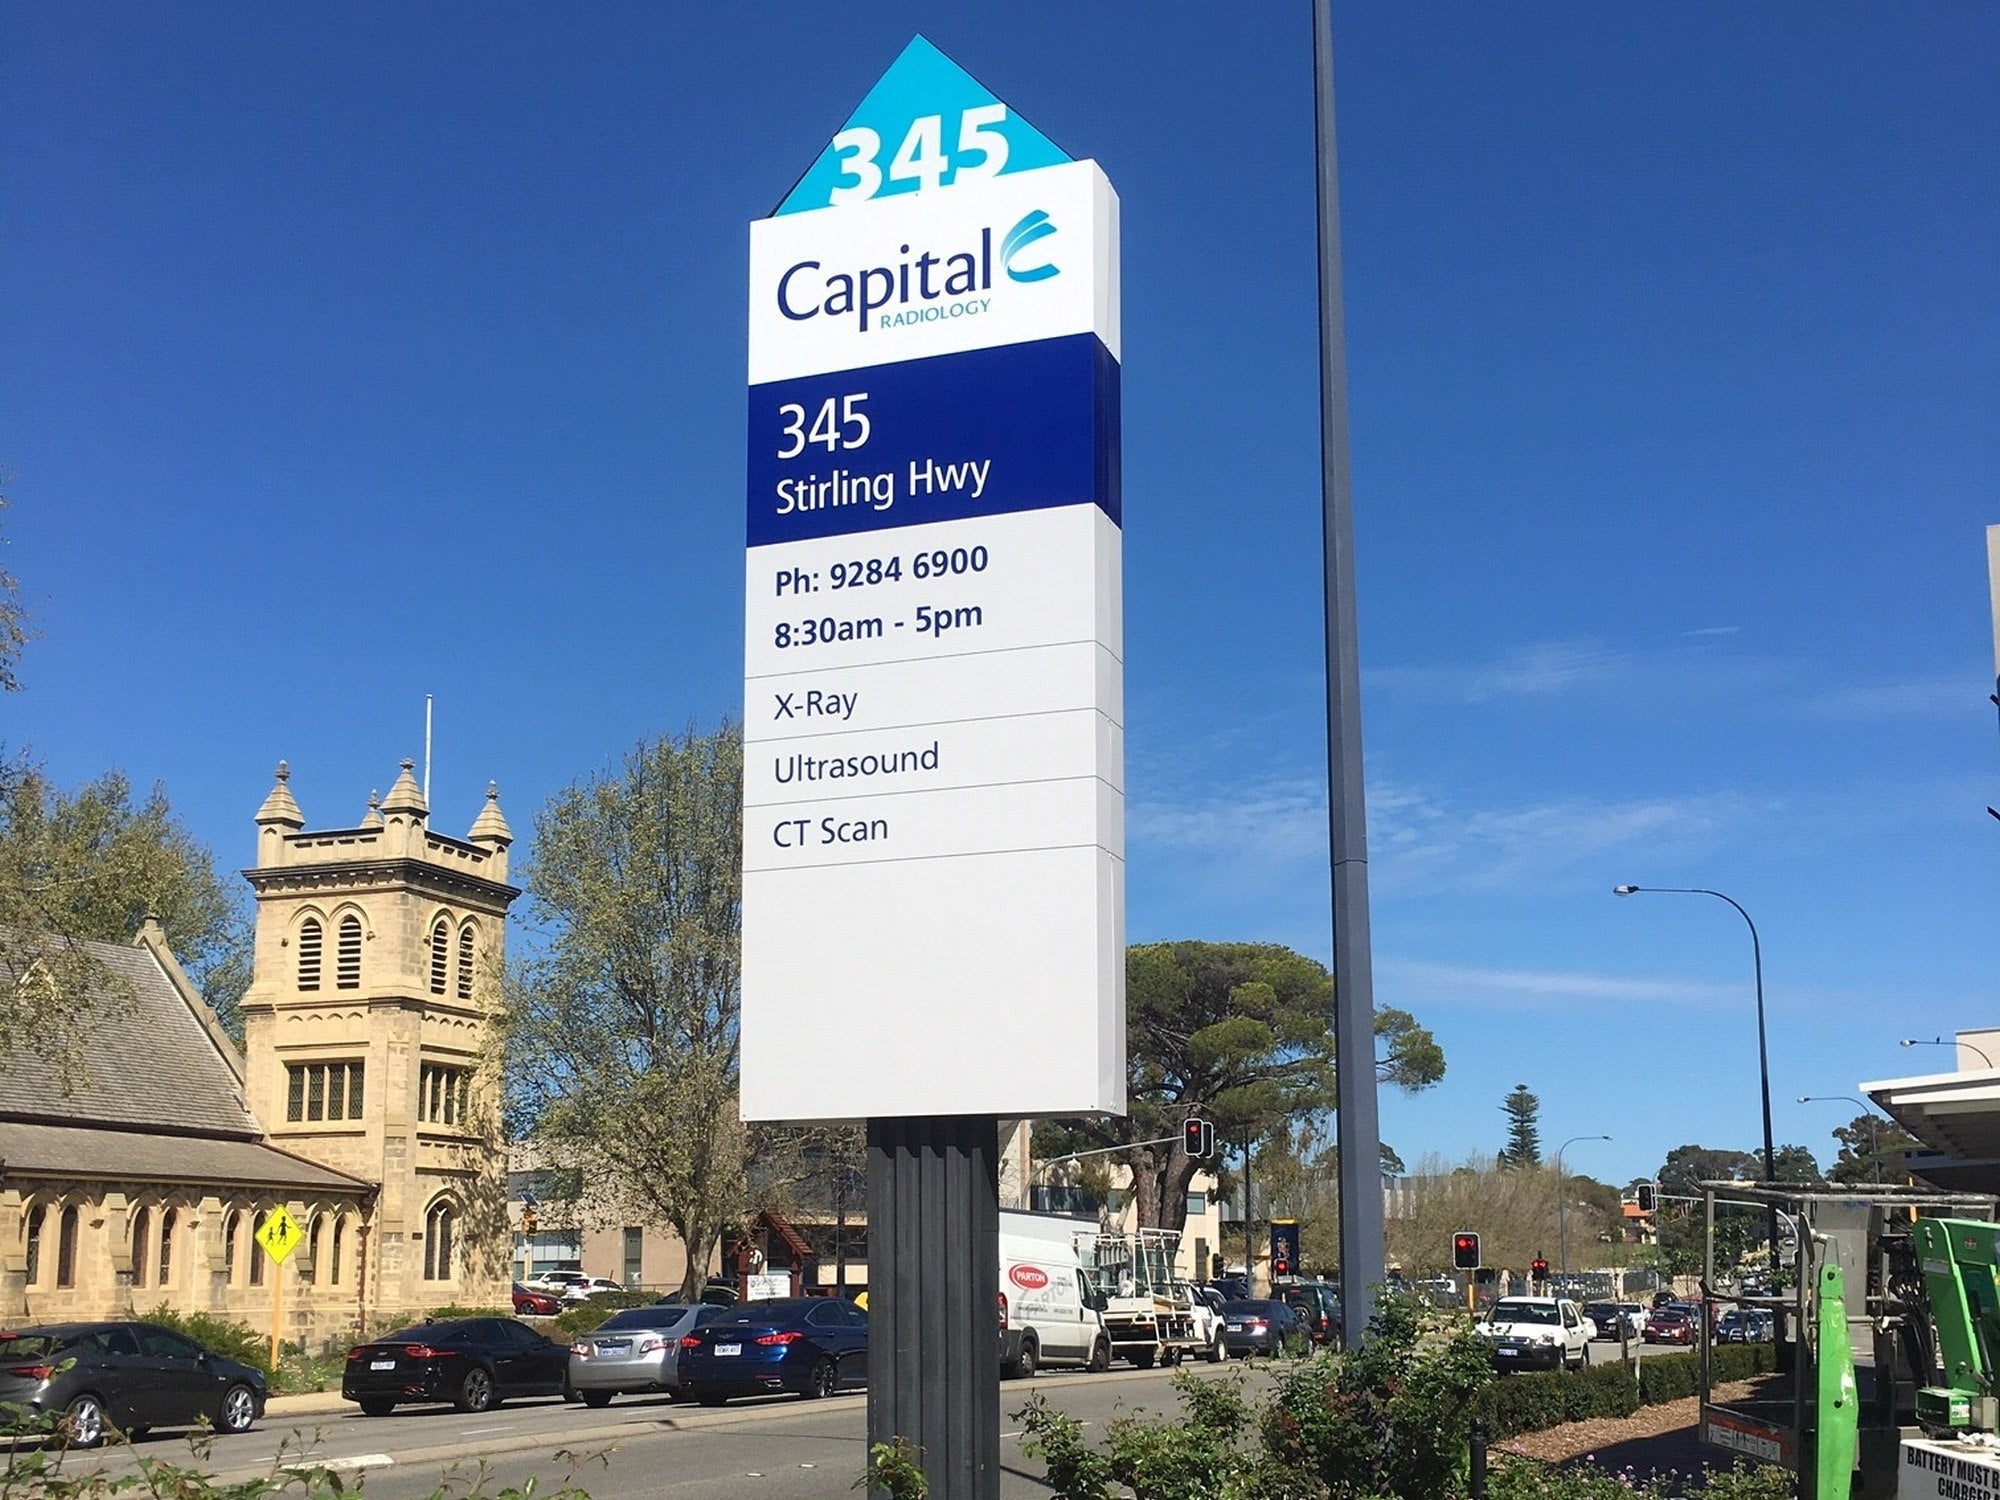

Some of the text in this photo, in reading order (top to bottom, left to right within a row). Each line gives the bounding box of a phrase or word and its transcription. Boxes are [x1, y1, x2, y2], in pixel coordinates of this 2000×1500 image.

[829, 103, 1010, 207] 345
[777, 227, 992, 332] Capital
[880, 298, 991, 329] RADIOLOGY
[777, 392, 871, 459] 345
[776, 458, 992, 514] Stirling Hwy
[776, 546, 989, 597] Ph: 9284 6900
[774, 617, 883, 649] 8:30am
[915, 606, 983, 639] 5pm
[774, 691, 858, 721] X-Ray
[775, 741, 939, 784] Ultrasound
[773, 817, 888, 848] CT Scan
[1016, 1271, 1046, 1284] PARTON
[1907, 1446, 1954, 1477] BATTERY
[1957, 1460, 1990, 1487] MUST
